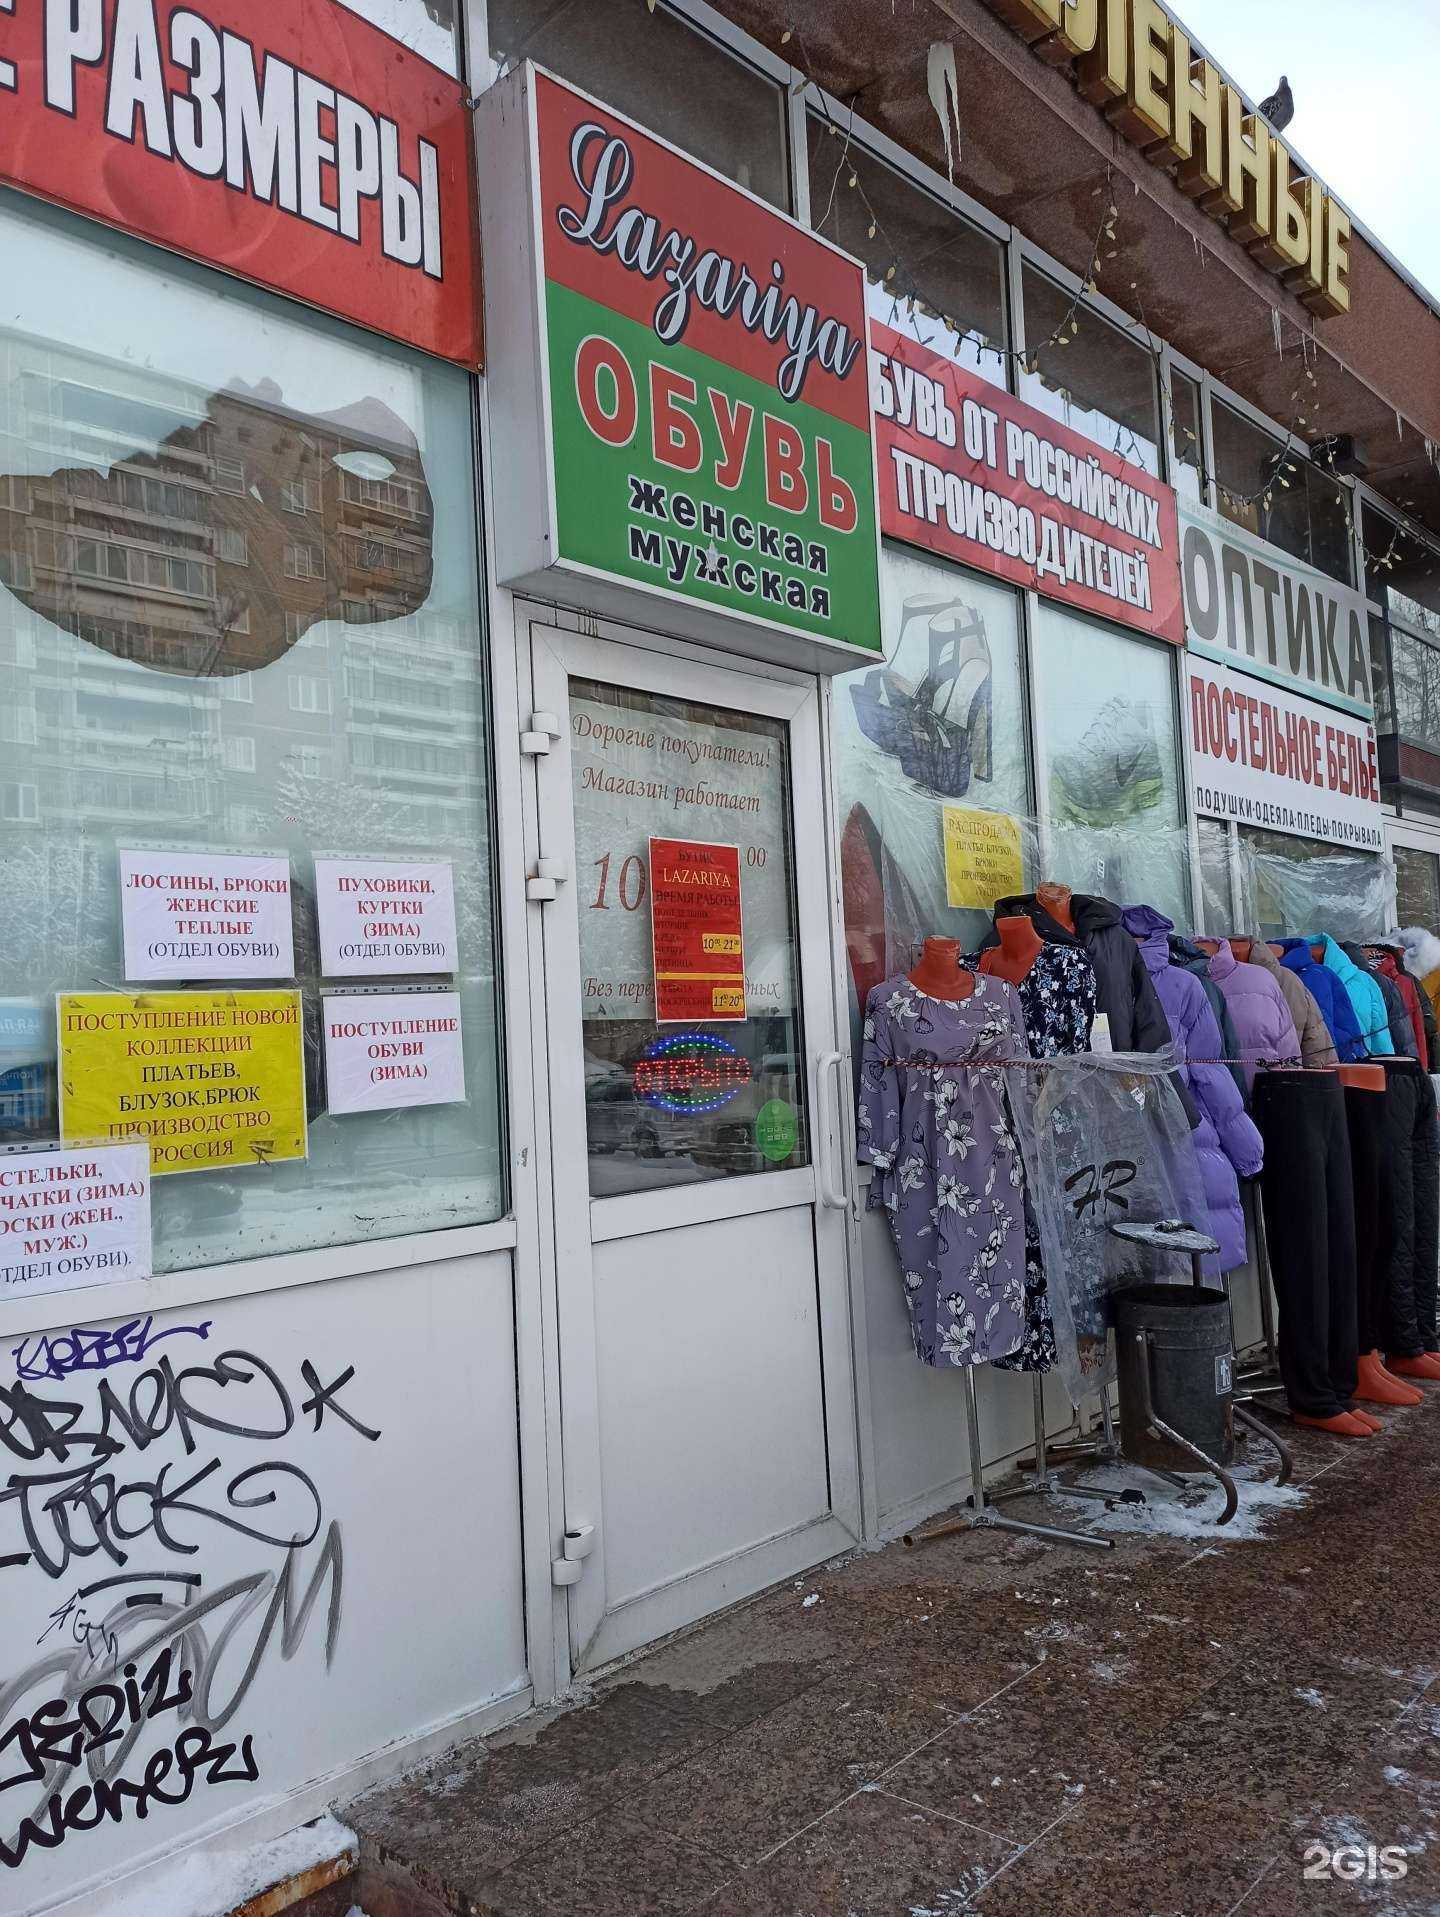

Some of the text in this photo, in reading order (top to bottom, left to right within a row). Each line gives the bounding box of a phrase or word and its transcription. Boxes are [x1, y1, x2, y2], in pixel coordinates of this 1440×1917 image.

[43, 0, 443, 281] РАЗМЕРЫ
[556, 121, 863, 403] Lazariya
[575, 334, 858, 533] ОБУВЬ
[962, 399, 998, 469] ОТ
[1005, 419, 1163, 550] РОССИЙСКИХ
[628, 474, 829, 576] женская
[628, 524, 831, 618] мужская
[1183, 526, 1371, 704] ОПТИКА
[573, 714, 771, 768] Дорогие покупатели!
[1191, 675, 1380, 803] ПОСТЕЛЬНОЕ БЕЛЬЁ
[582, 766, 761, 812] Магазин работает
[127, 873, 288, 893] ЛОСИНЫ, БРЮКИ
[338, 877, 435, 895] ПУХОВИКИ,
[166, 898, 260, 913] ЖЕНСКИЕ
[358, 900, 424, 915] КУРТКИ
[175, 920, 254, 935] ТЕПЛЫЕ
[363, 922, 421, 940] (ЗИМА)
[148, 942, 280, 960] (ОТДЕЛ ОБУВИ)
[339, 942, 446, 960] (ОТДЕЛ ОБУВИ)
[584, 977, 613, 997] Без
[66, 1007, 298, 1032] ПОСТУПЛЕНИЕ НОВОЙ
[331, 1018, 458, 1038] ПОСТУПЛЕНИЕ
[127, 1035, 252, 1057] КОЛЛЕКЦИИ
[367, 1042, 424, 1059] ОБУВИ
[142, 1062, 241, 1083] ПЛАТЬЕВ,
[370, 1064, 427, 1083] (ЗИМА)
[634, 1056, 751, 1093] ОТКРЫТО
[109, 1110, 271, 1138] ПРОИЗВОДСТВО
[153, 1140, 234, 1163] РОССИЯ
[0, 1163, 103, 1187] СТЕЛЬКИ,
[77, 1181, 145, 1204] (ЗИМА)
[61, 1206, 123, 1229] (ЖЕН.,
[23, 1233, 88, 1256] МУЖ.)
[58, 1250, 132, 1274] ОБУВИ).
